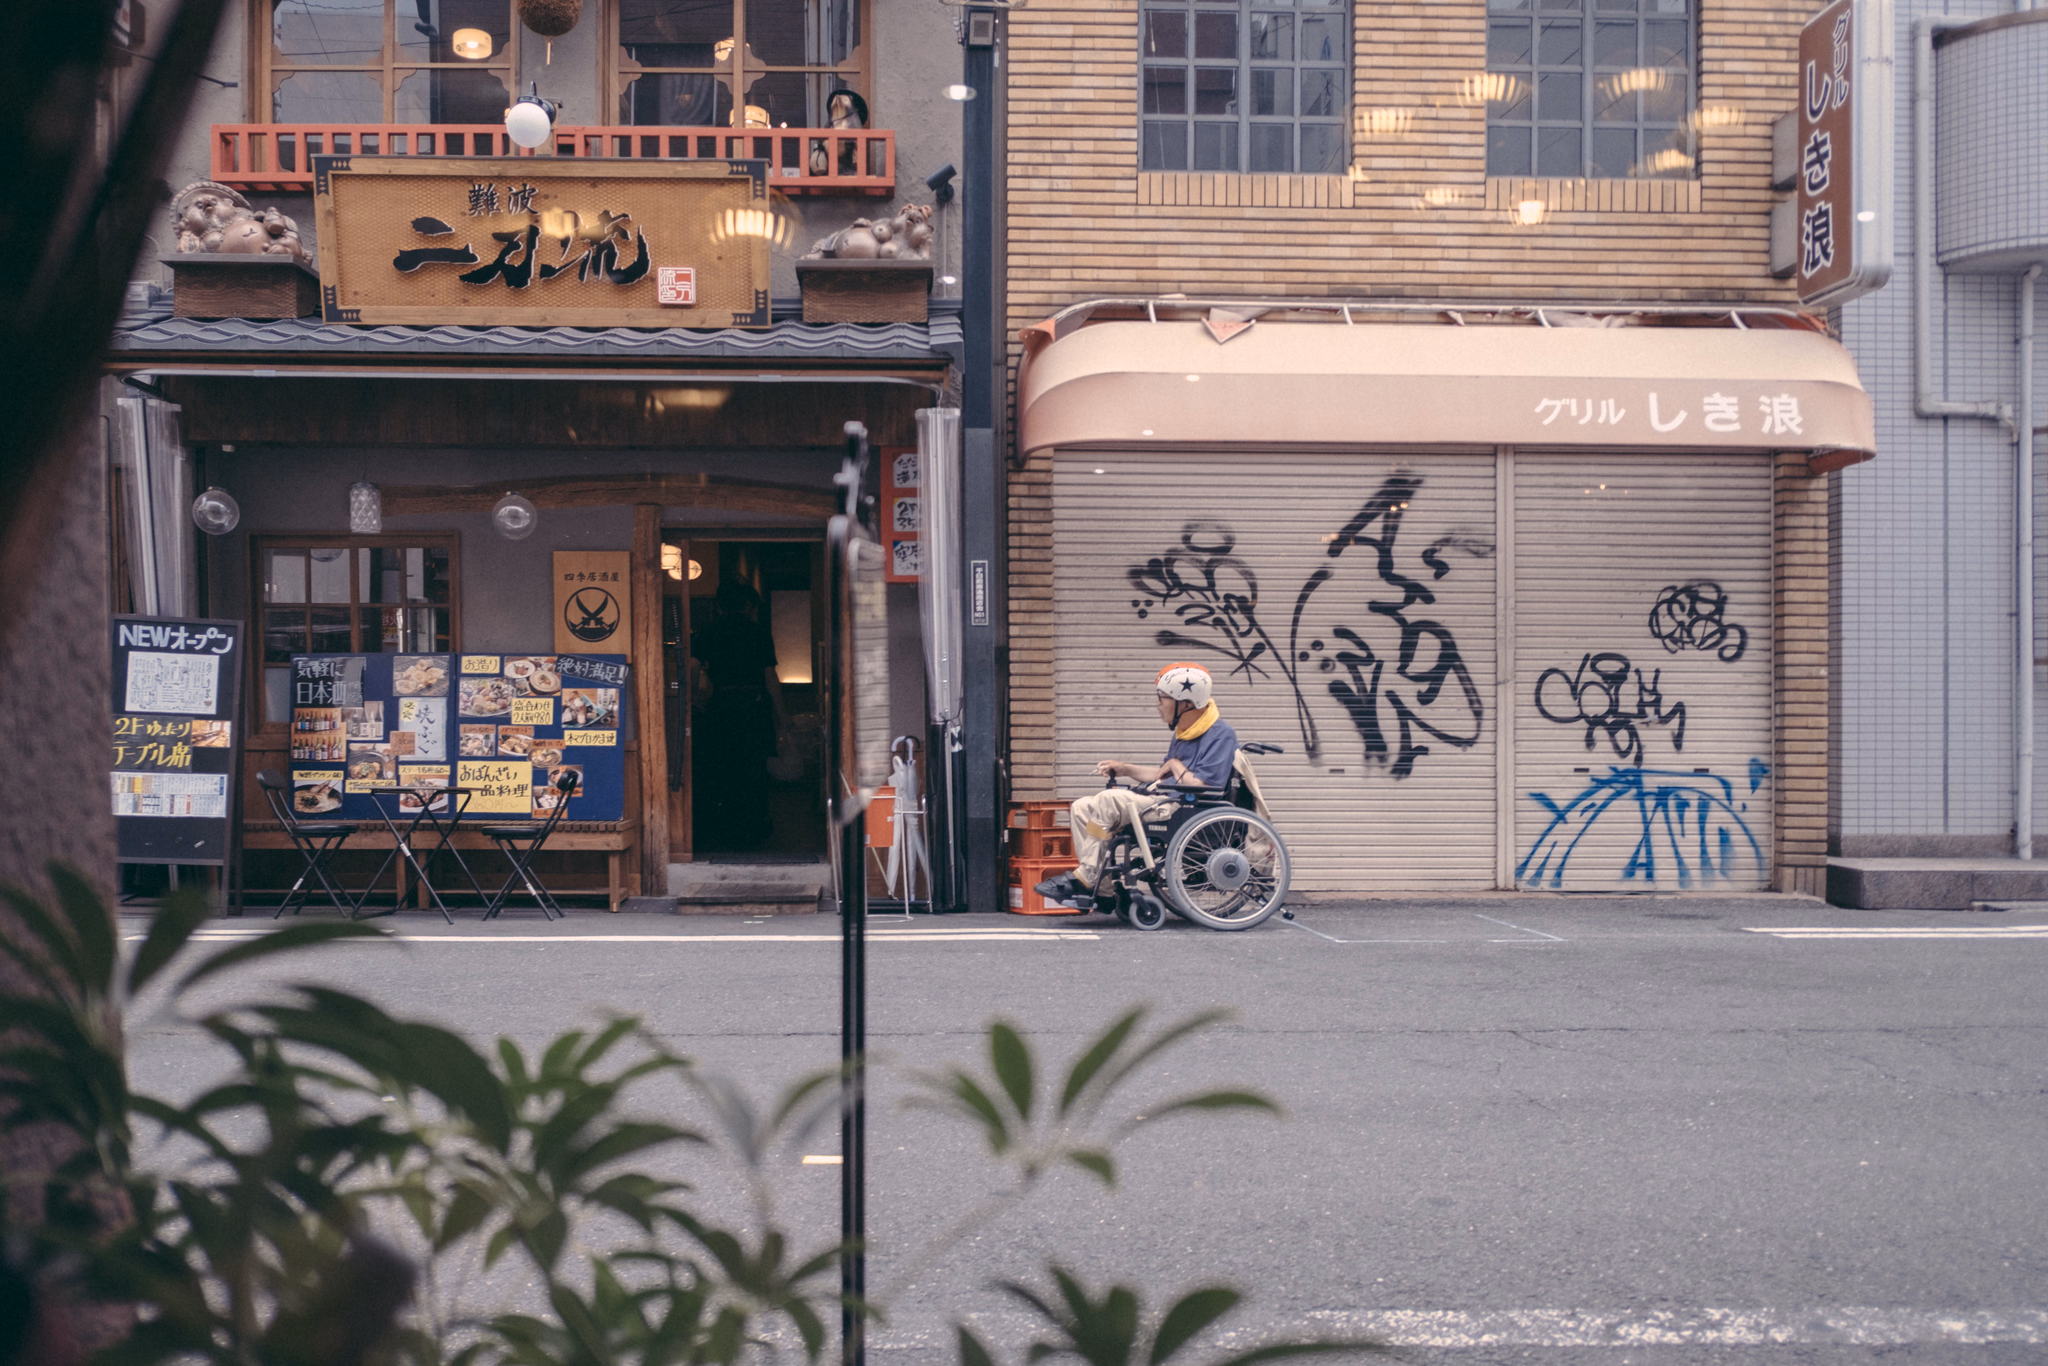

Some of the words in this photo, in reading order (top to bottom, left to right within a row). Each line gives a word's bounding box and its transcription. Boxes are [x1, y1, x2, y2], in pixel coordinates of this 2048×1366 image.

[1832, 9, 1850, 110] グリル
[1802, 59, 1835, 280] しき浪
[467, 175, 541, 217] 難波
[393, 209, 651, 290] 二刀流
[1534, 396, 1627, 426] グリル
[1648, 392, 1804, 436] しき浪
[564, 571, 620, 582] 四季居酒屋
[119, 624, 233, 654] NEWオープン
[464, 658, 498, 672] お造り
[297, 680, 347, 705] 日本酒
[114, 740, 192, 768] テーブル席
[460, 764, 518, 782] おばんざい
